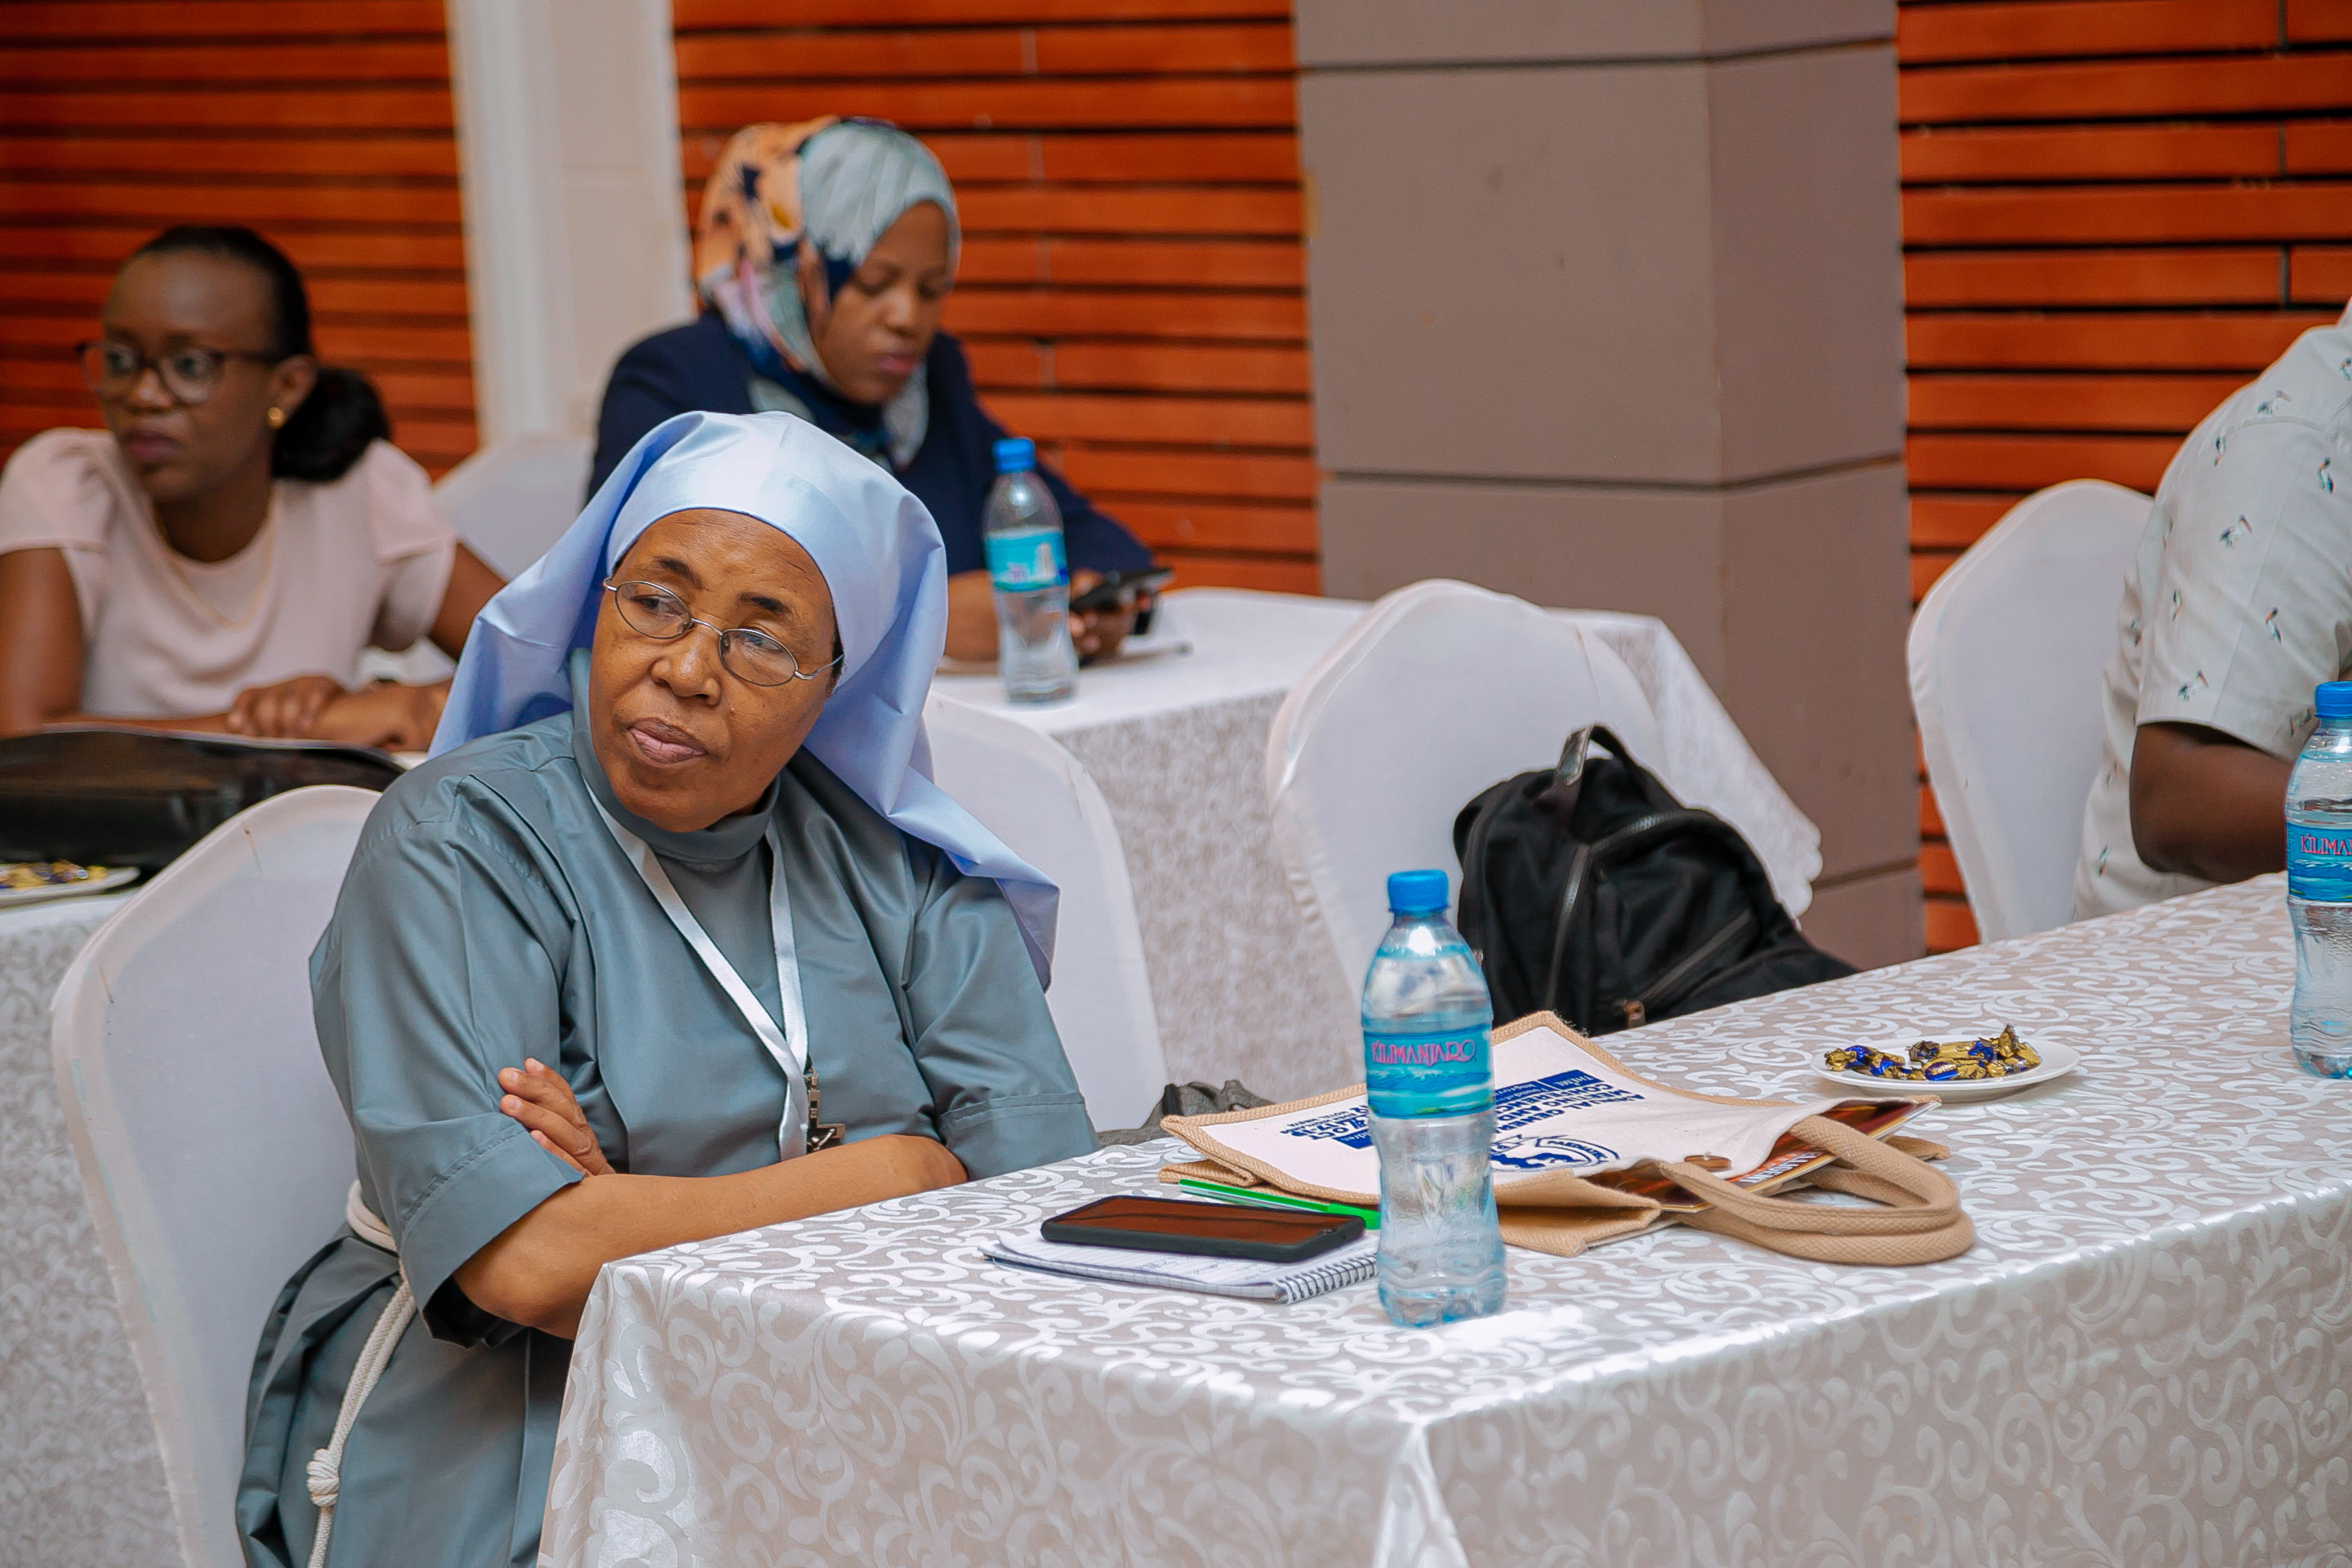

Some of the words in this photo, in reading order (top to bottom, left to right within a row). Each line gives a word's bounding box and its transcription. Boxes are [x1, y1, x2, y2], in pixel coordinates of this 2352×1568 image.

[1371, 1039, 1476, 1067] KILIMANJARO
[1541, 1089, 1633, 1107] MEETING
[1561, 1094, 1646, 1109] ANNUAL
[1497, 1105, 1543, 1121] AND
[1308, 1126, 1349, 1140] OCT
